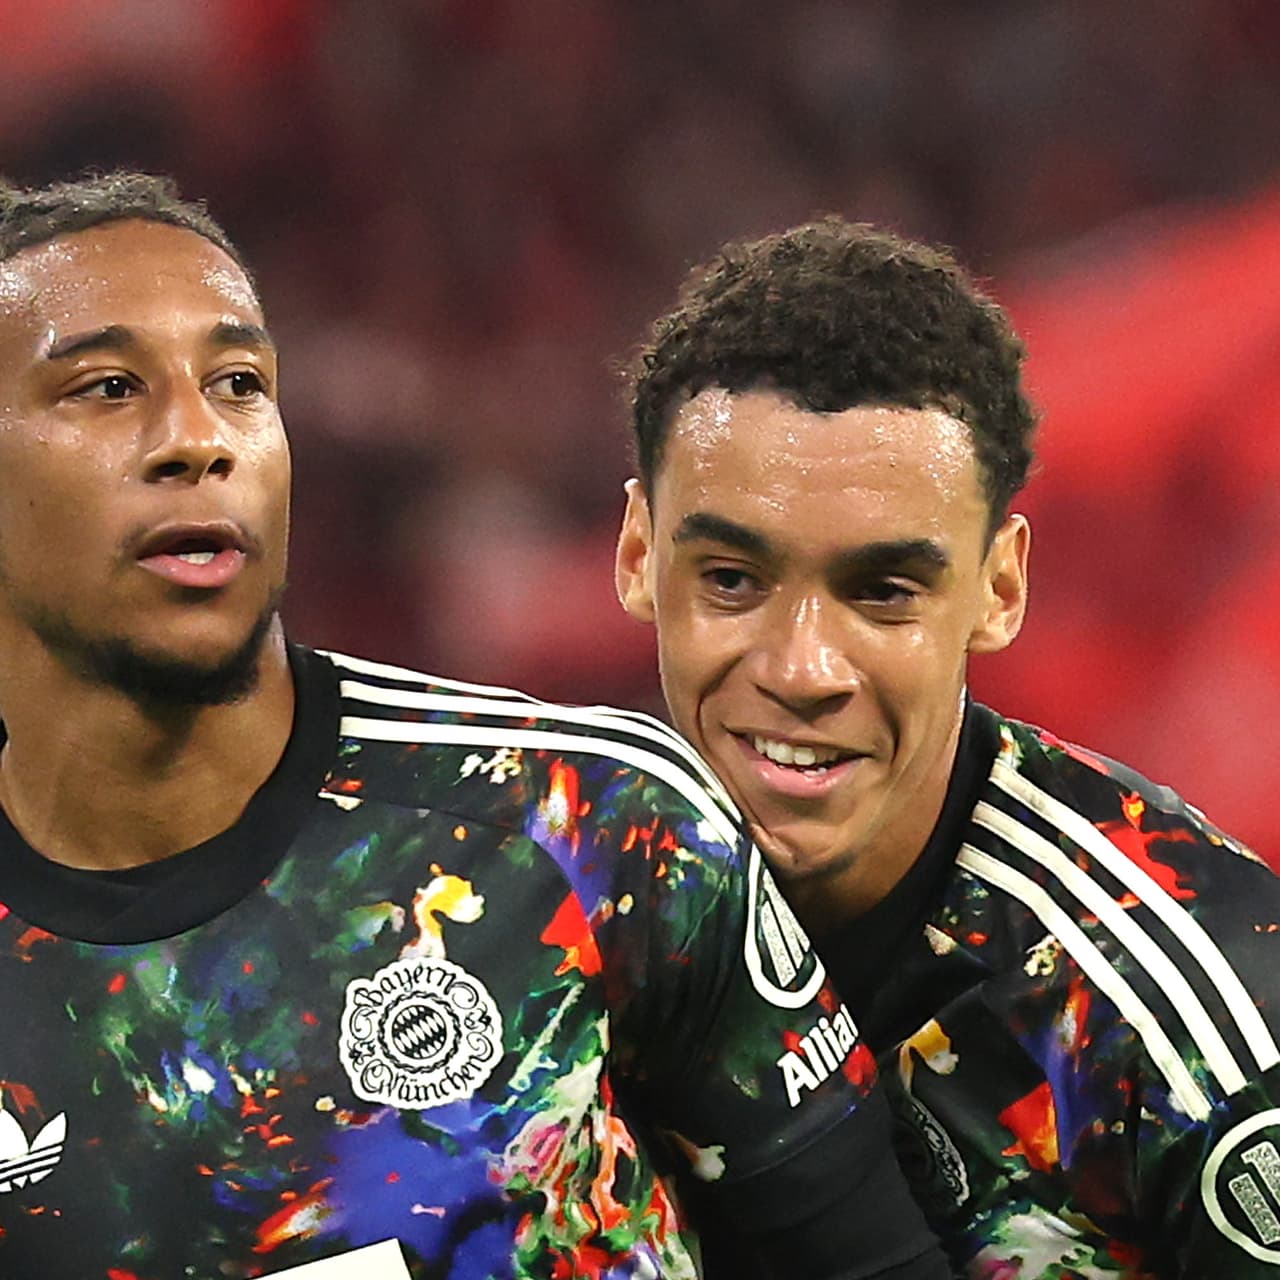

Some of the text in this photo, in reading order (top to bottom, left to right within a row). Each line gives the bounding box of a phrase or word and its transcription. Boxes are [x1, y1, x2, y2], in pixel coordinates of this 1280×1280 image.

[351, 963, 460, 1012] Bayern
[360, 1058, 487, 1102] München
[776, 1003, 859, 1108] Allia
